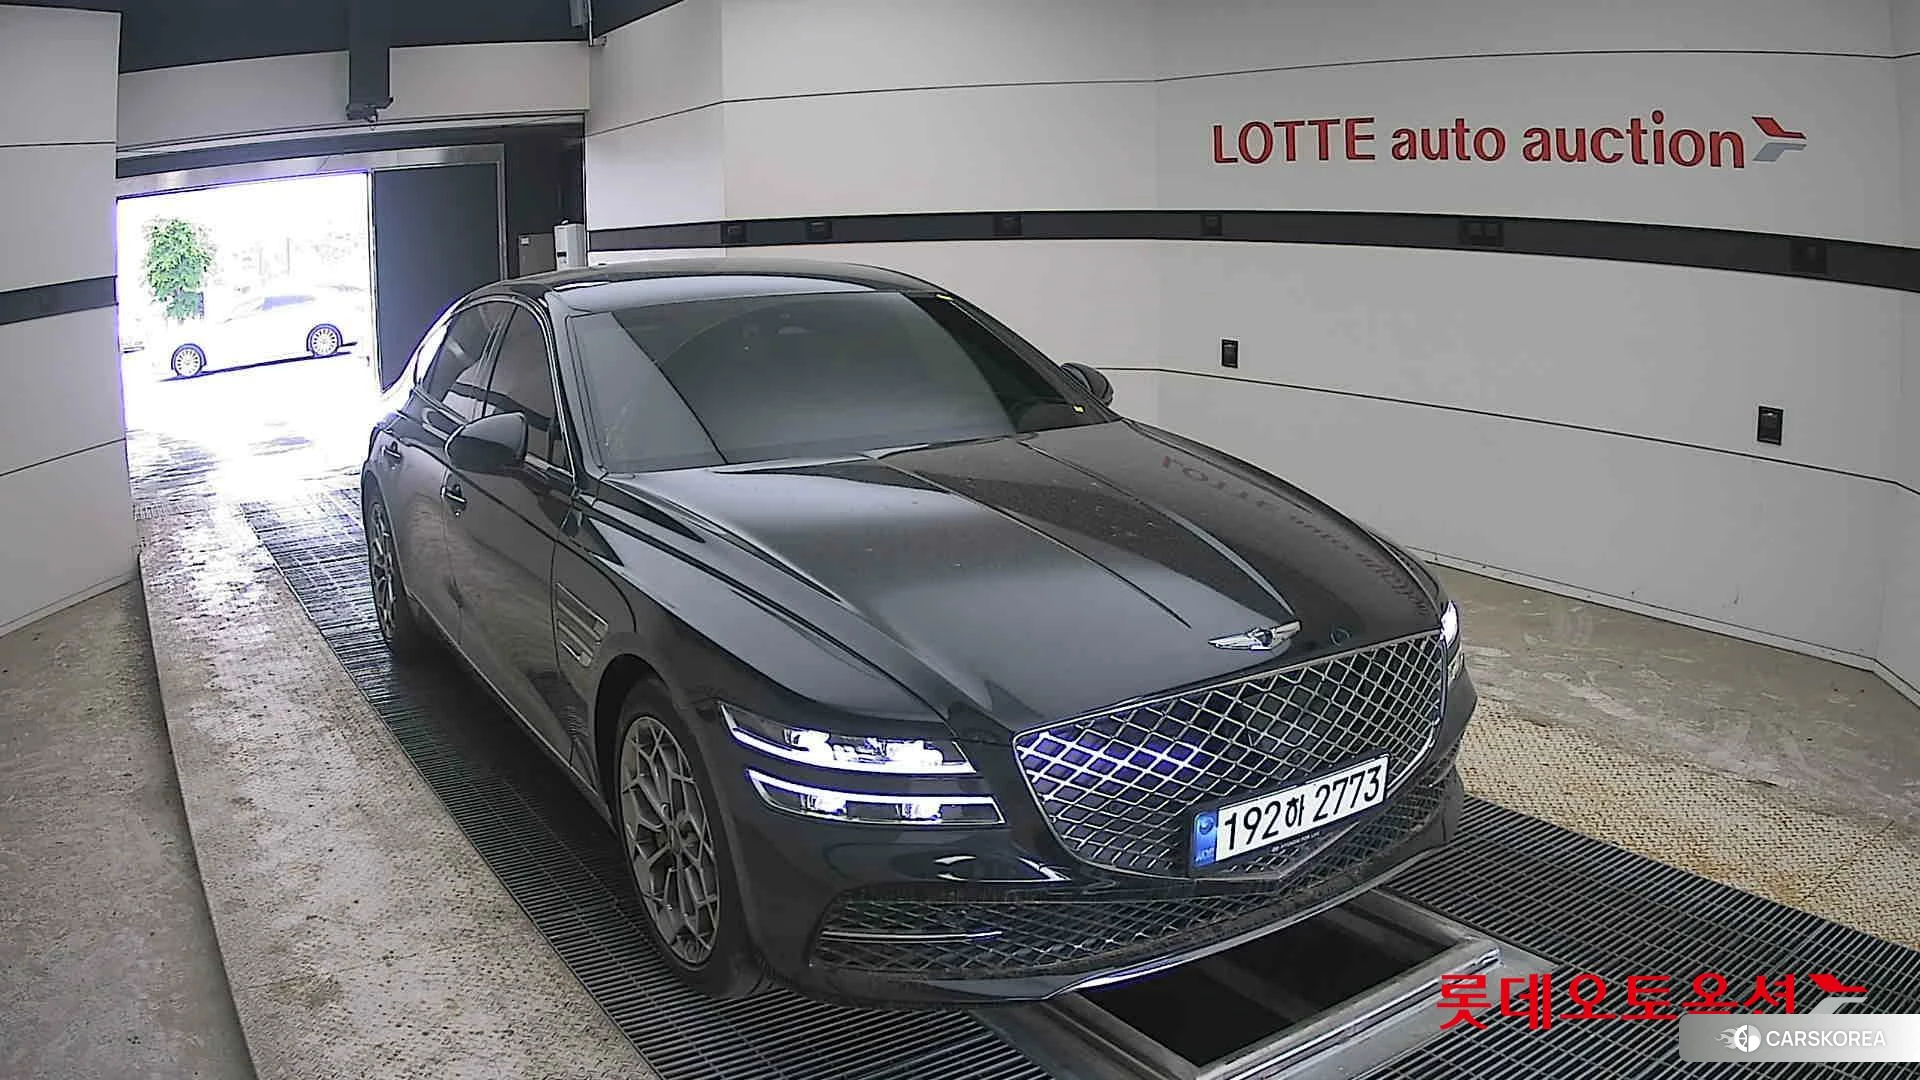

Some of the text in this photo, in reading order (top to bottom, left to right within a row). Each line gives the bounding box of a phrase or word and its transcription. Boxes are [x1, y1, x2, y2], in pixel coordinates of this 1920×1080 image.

[1212, 109, 1747, 169] LOTTE auto auction
[1224, 764, 1383, 851] 192하 2773
